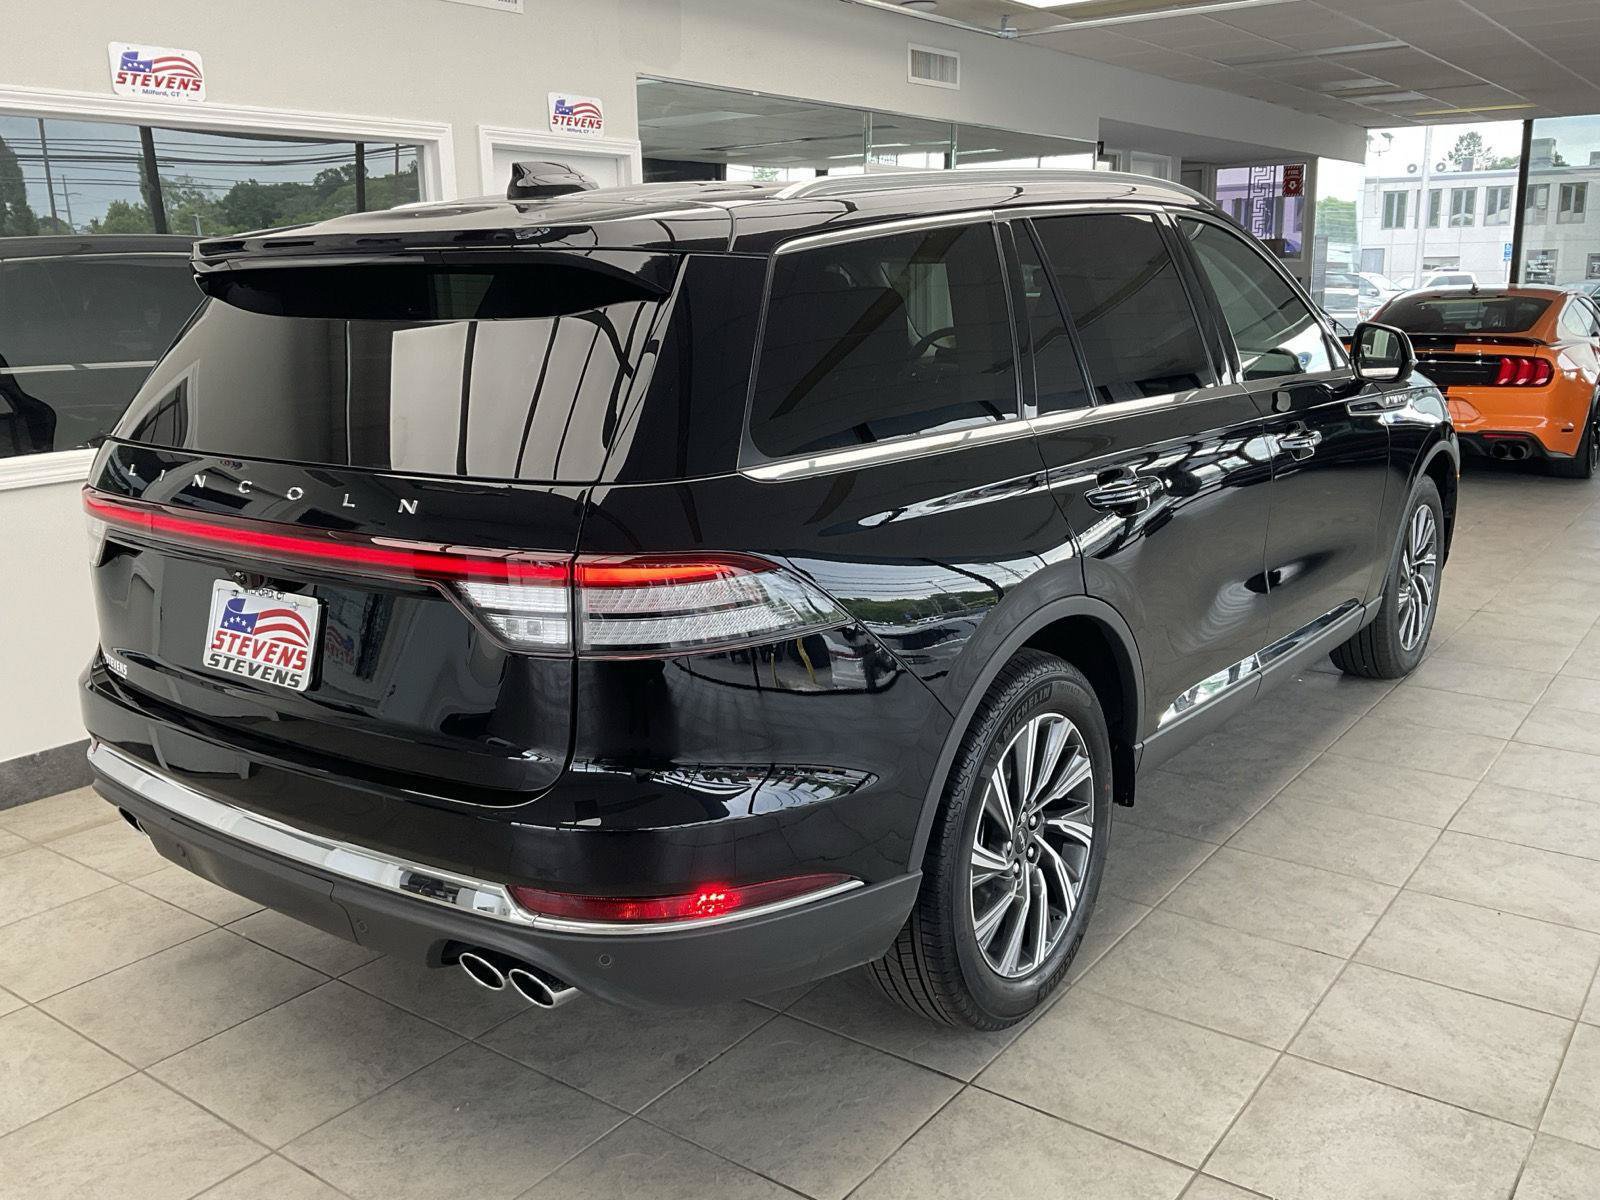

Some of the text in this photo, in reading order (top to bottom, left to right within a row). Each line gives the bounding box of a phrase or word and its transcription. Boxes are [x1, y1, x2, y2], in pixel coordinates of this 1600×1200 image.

[115, 71, 203, 91] STEVENS
[552, 115, 603, 129] STEVENS
[128, 463, 419, 515] LINCOLN
[211, 630, 308, 671] STEVENS
[207, 653, 303, 688] STEVENS
